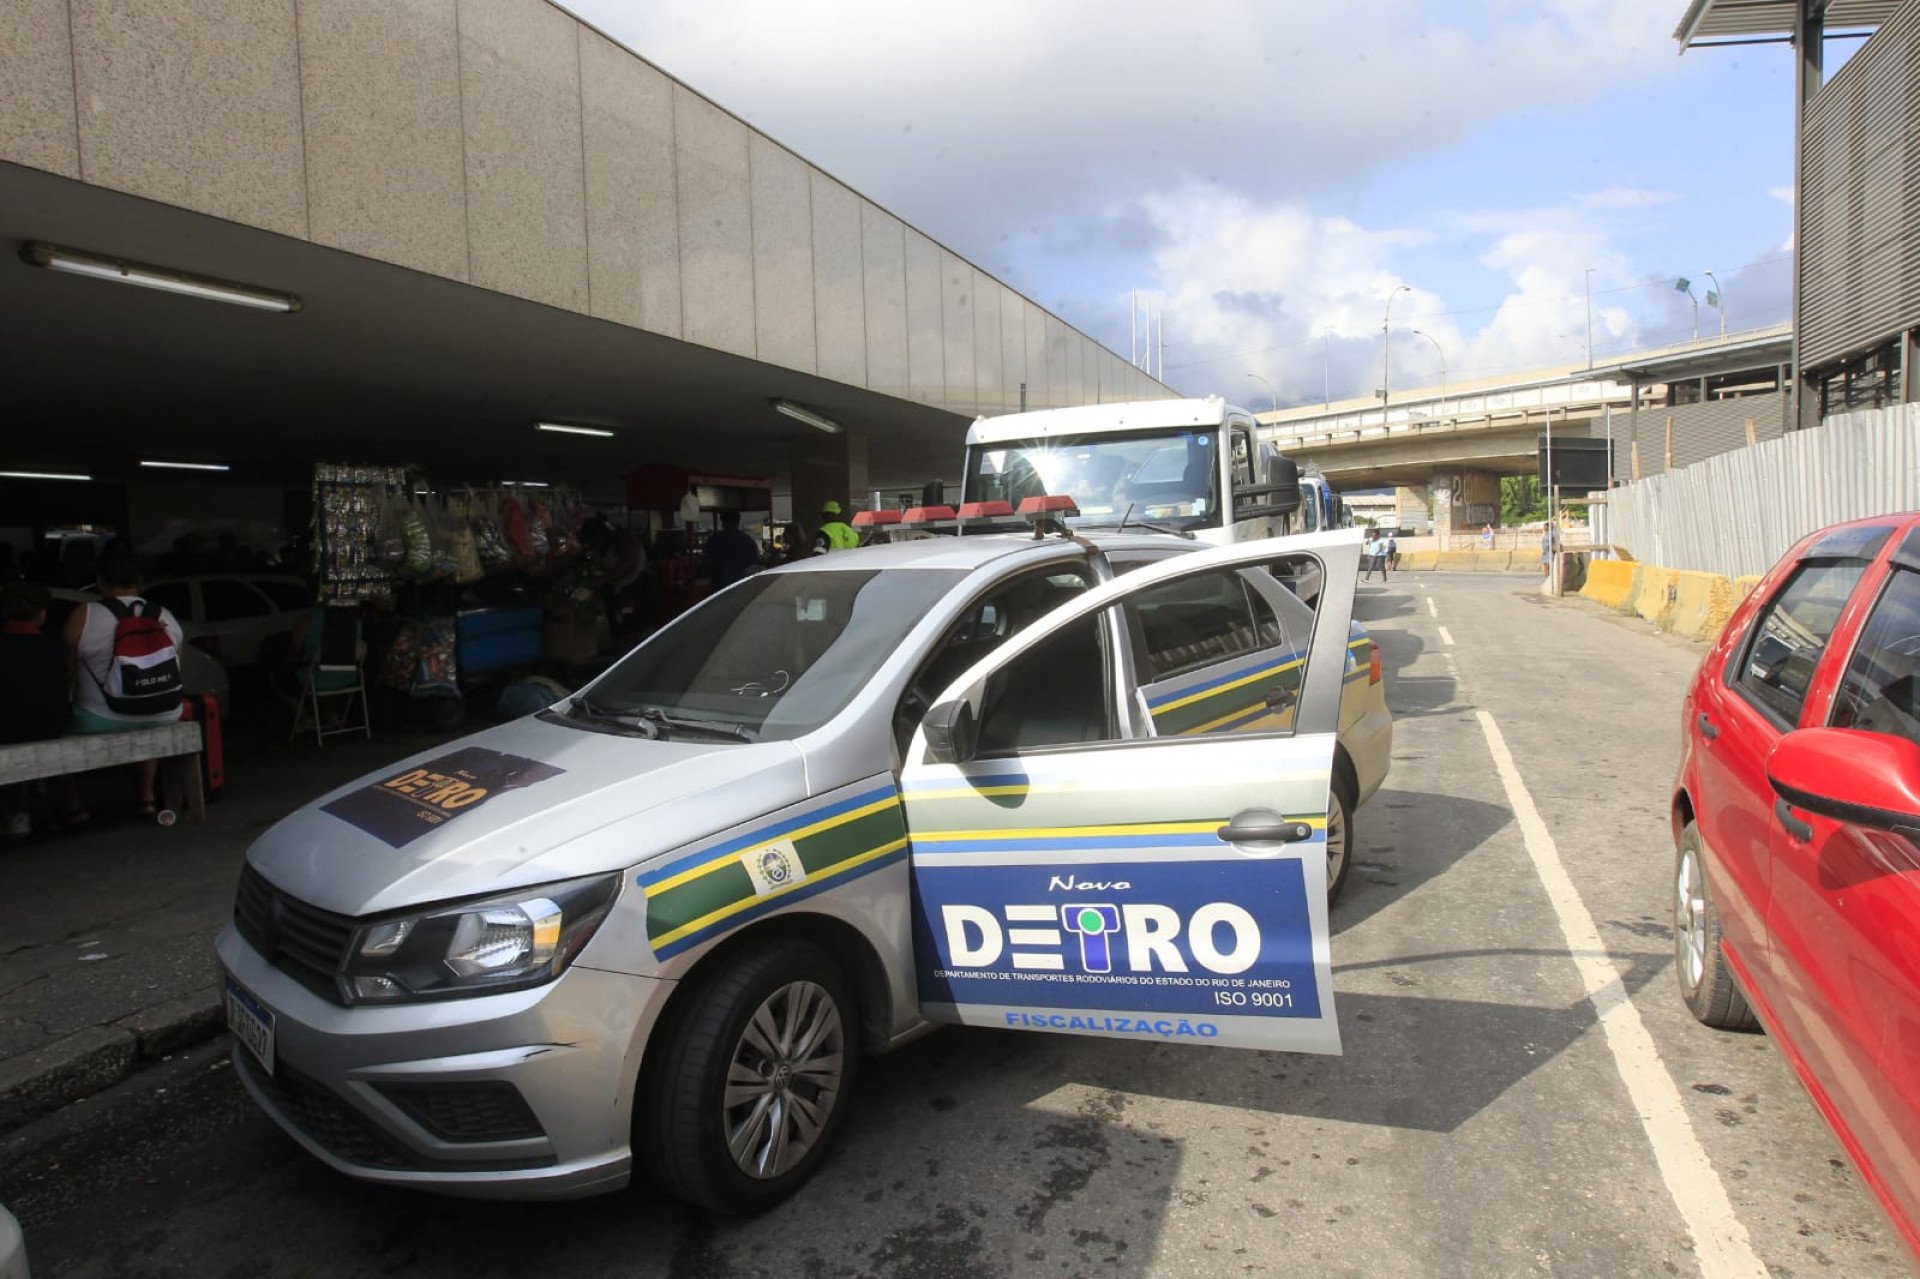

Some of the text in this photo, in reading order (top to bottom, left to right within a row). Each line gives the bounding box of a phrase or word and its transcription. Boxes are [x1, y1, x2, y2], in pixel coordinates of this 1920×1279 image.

[1048, 874, 1132, 892] Novo
[941, 902, 1261, 974] DETRO
[934, 969, 997, 980] DEPARTAMENTO
[999, 972, 1011, 981] DE
[1012, 972, 1075, 983] TRANSPORTES
[1140, 976, 1154, 985] DO
[1155, 977, 1194, 986] ESTADO
[1195, 978, 1210, 987] DO
[1211, 978, 1230, 987] RIO
[1232, 979, 1245, 987] DE
[1247, 979, 1291, 988] JANEIRO
[1214, 991, 1293, 1008] ISO 9001
[1005, 1012, 1218, 1038] FISCALIZAÇÃO
